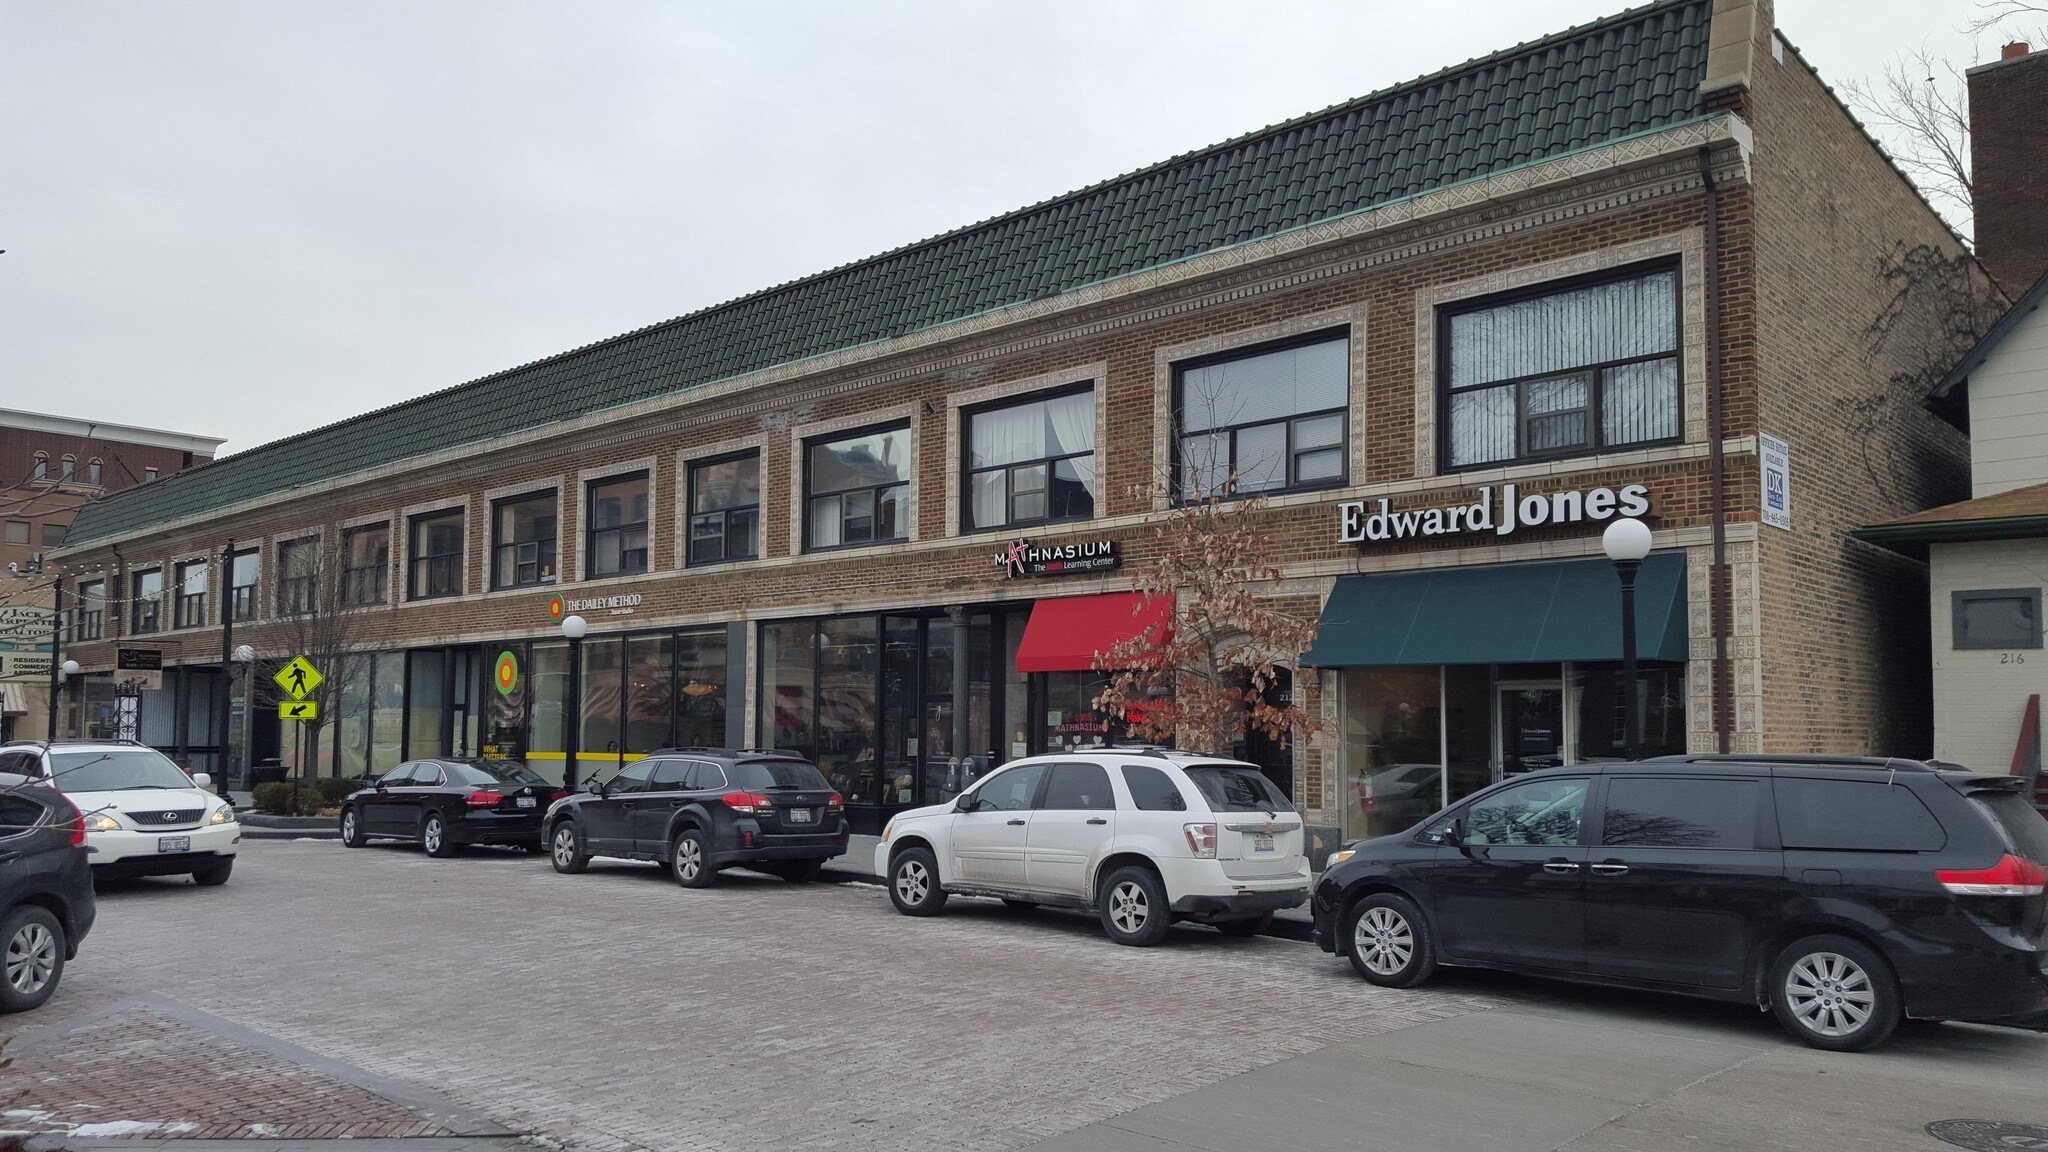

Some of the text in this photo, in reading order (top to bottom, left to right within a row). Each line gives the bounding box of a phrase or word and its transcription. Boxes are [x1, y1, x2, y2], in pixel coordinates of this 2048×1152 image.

[1768, 470, 1782, 494] DK
[1338, 483, 1649, 543] Edward Jones
[994, 538, 1111, 578] MATHNASIUM
[1034, 564, 1046, 572] The
[1064, 558, 1091, 569] Learning
[1092, 557, 1115, 566] Center
[568, 594, 641, 612] THE DAILEY METHOD
[0, 618, 64, 627] RPENTE
[2000, 653, 2025, 665] 216
[483, 745, 499, 753] WHAT
